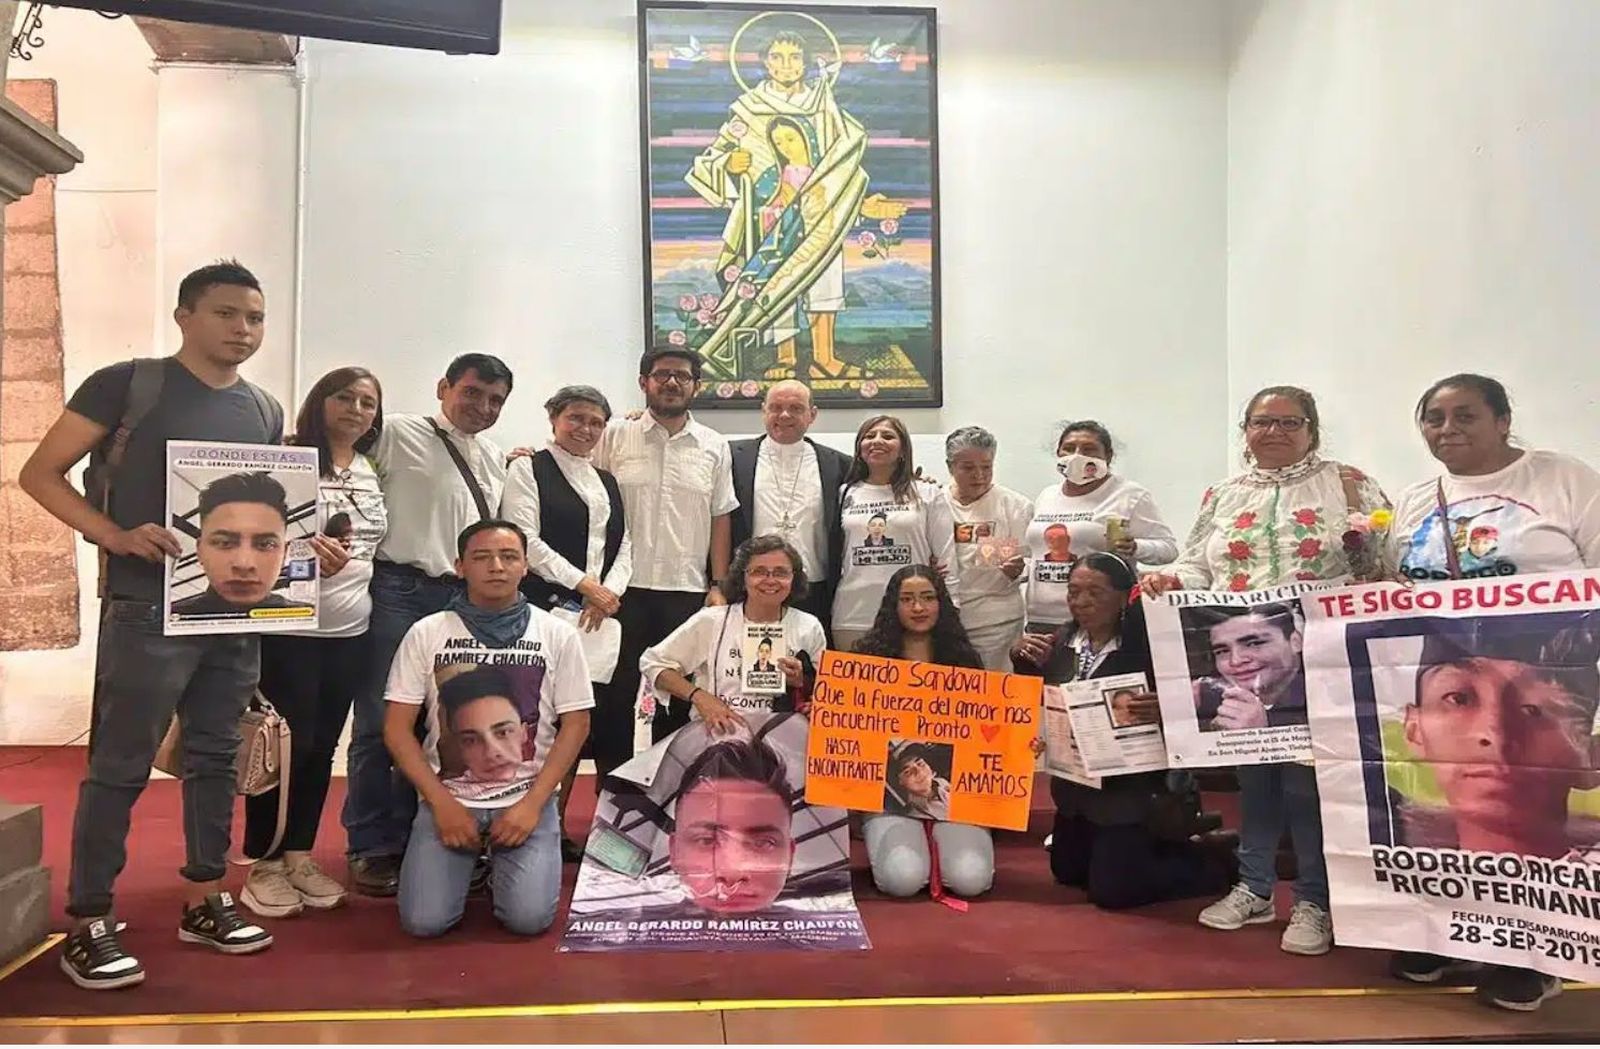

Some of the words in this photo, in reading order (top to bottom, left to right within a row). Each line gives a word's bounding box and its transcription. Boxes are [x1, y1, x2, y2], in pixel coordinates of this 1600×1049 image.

[1318, 594, 1356, 618] TE
[1364, 589, 1443, 614] SIGO
[819, 651, 899, 685] Leonardo
[908, 661, 989, 695] Sandoval
[814, 680, 845, 706] Que
[853, 687, 866, 708] la
[872, 688, 922, 713] fuerza
[929, 698, 951, 717] del
[955, 701, 997, 722] amor
[1004, 705, 1033, 724] nos
[825, 737, 862, 756] HASTA
[808, 757, 885, 782] ENCONTRARTE
[979, 753, 1004, 772] TE
[955, 771, 1029, 799] AMAMOS
[1372, 849, 1523, 878] RODRIGO
[628, 919, 703, 931] GERARDO
[708, 917, 780, 930] RAMÍREZ
[783, 917, 859, 930] CHAUFÓN
[1451, 910, 1494, 925] FECHA
[1497, 917, 1516, 928] DE
